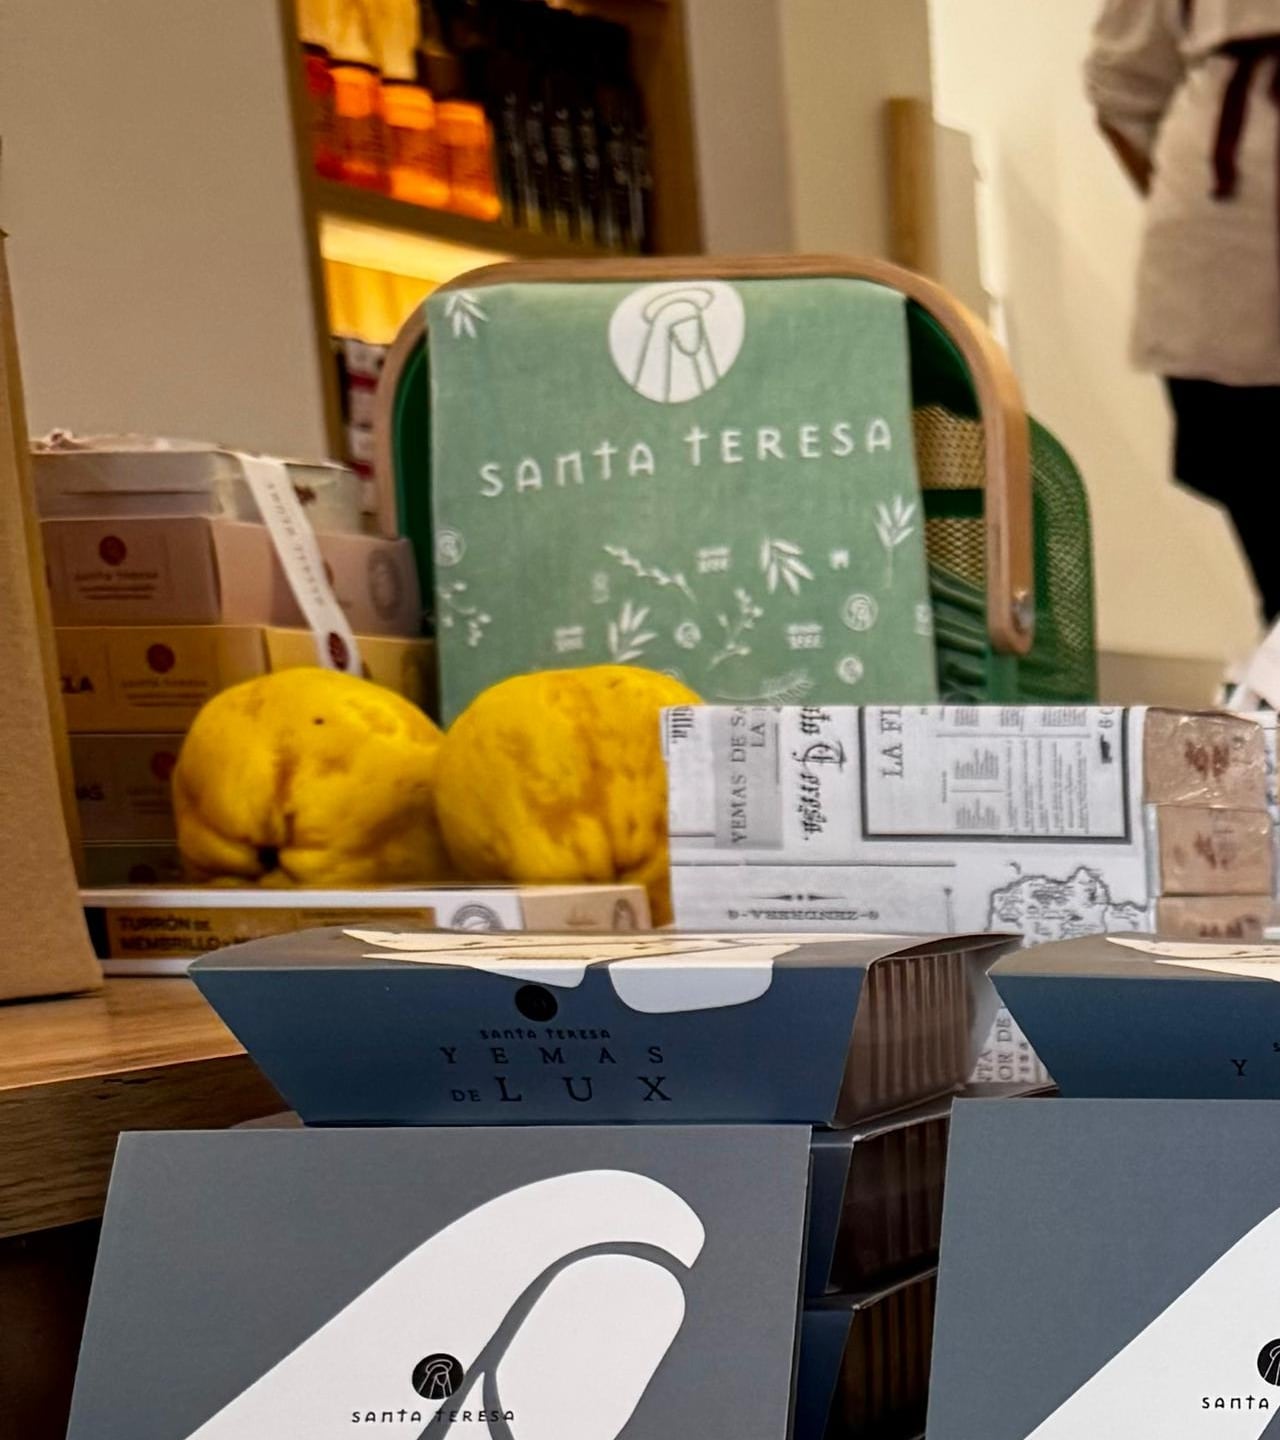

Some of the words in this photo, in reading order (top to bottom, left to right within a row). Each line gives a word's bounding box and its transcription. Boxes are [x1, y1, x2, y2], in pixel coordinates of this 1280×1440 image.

[479, 442, 655, 497] SANTA
[683, 418, 892, 466] TERESA
[751, 722, 766, 748] LA
[731, 733, 748, 763] DE
[731, 775, 748, 843] YEMAS
[479, 1027, 537, 1040] SANTA
[545, 1027, 611, 1040] TERESA
[440, 1047, 665, 1064] YEMAS
[451, 1090, 480, 1102] DE
[499, 1077, 671, 1102] LUX
[1201, 1395, 1270, 1411] SANTA
[351, 1409, 422, 1424] SANTA
[434, 1408, 515, 1423] TERESA
